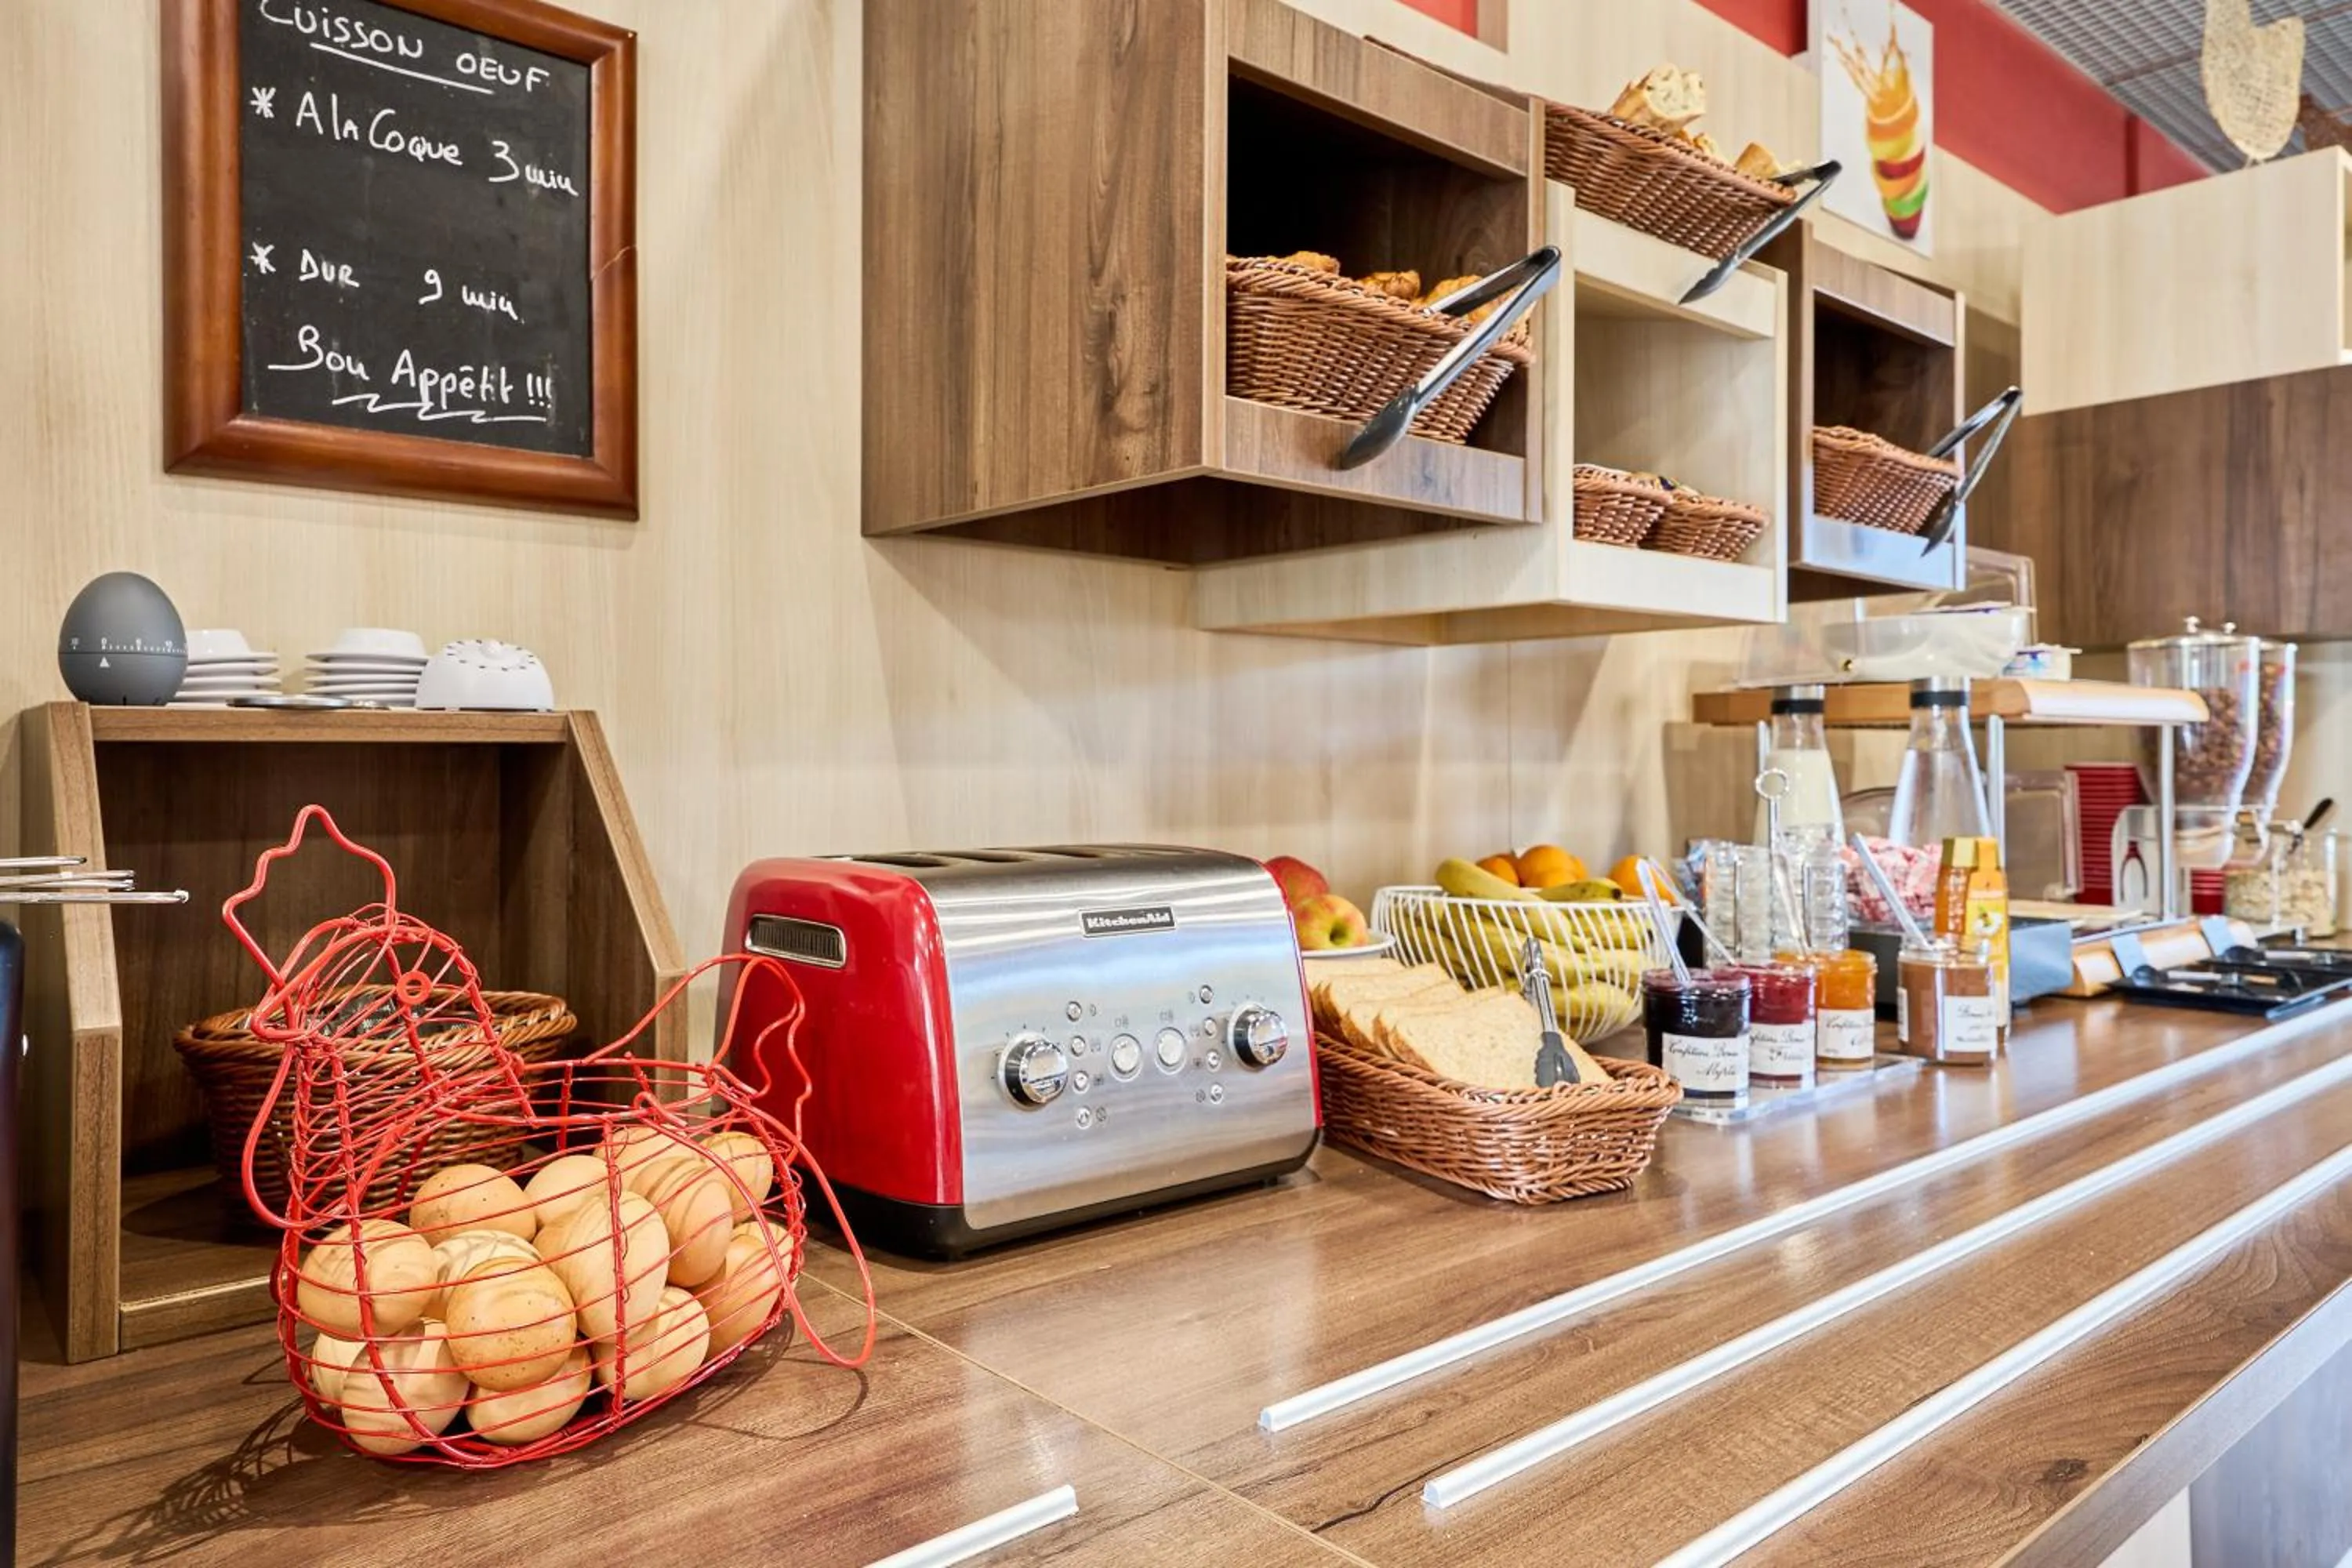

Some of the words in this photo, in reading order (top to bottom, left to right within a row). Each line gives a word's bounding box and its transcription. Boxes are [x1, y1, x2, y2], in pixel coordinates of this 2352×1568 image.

[456, 53, 550, 93] OEUF
[296, 91, 324, 135] A
[488, 140, 520, 183] 3
[299, 249, 360, 288] DUR
[418, 269, 443, 305] 9
[268, 325, 370, 381] Bon
[1086, 912, 1171, 928] KitchenAid
